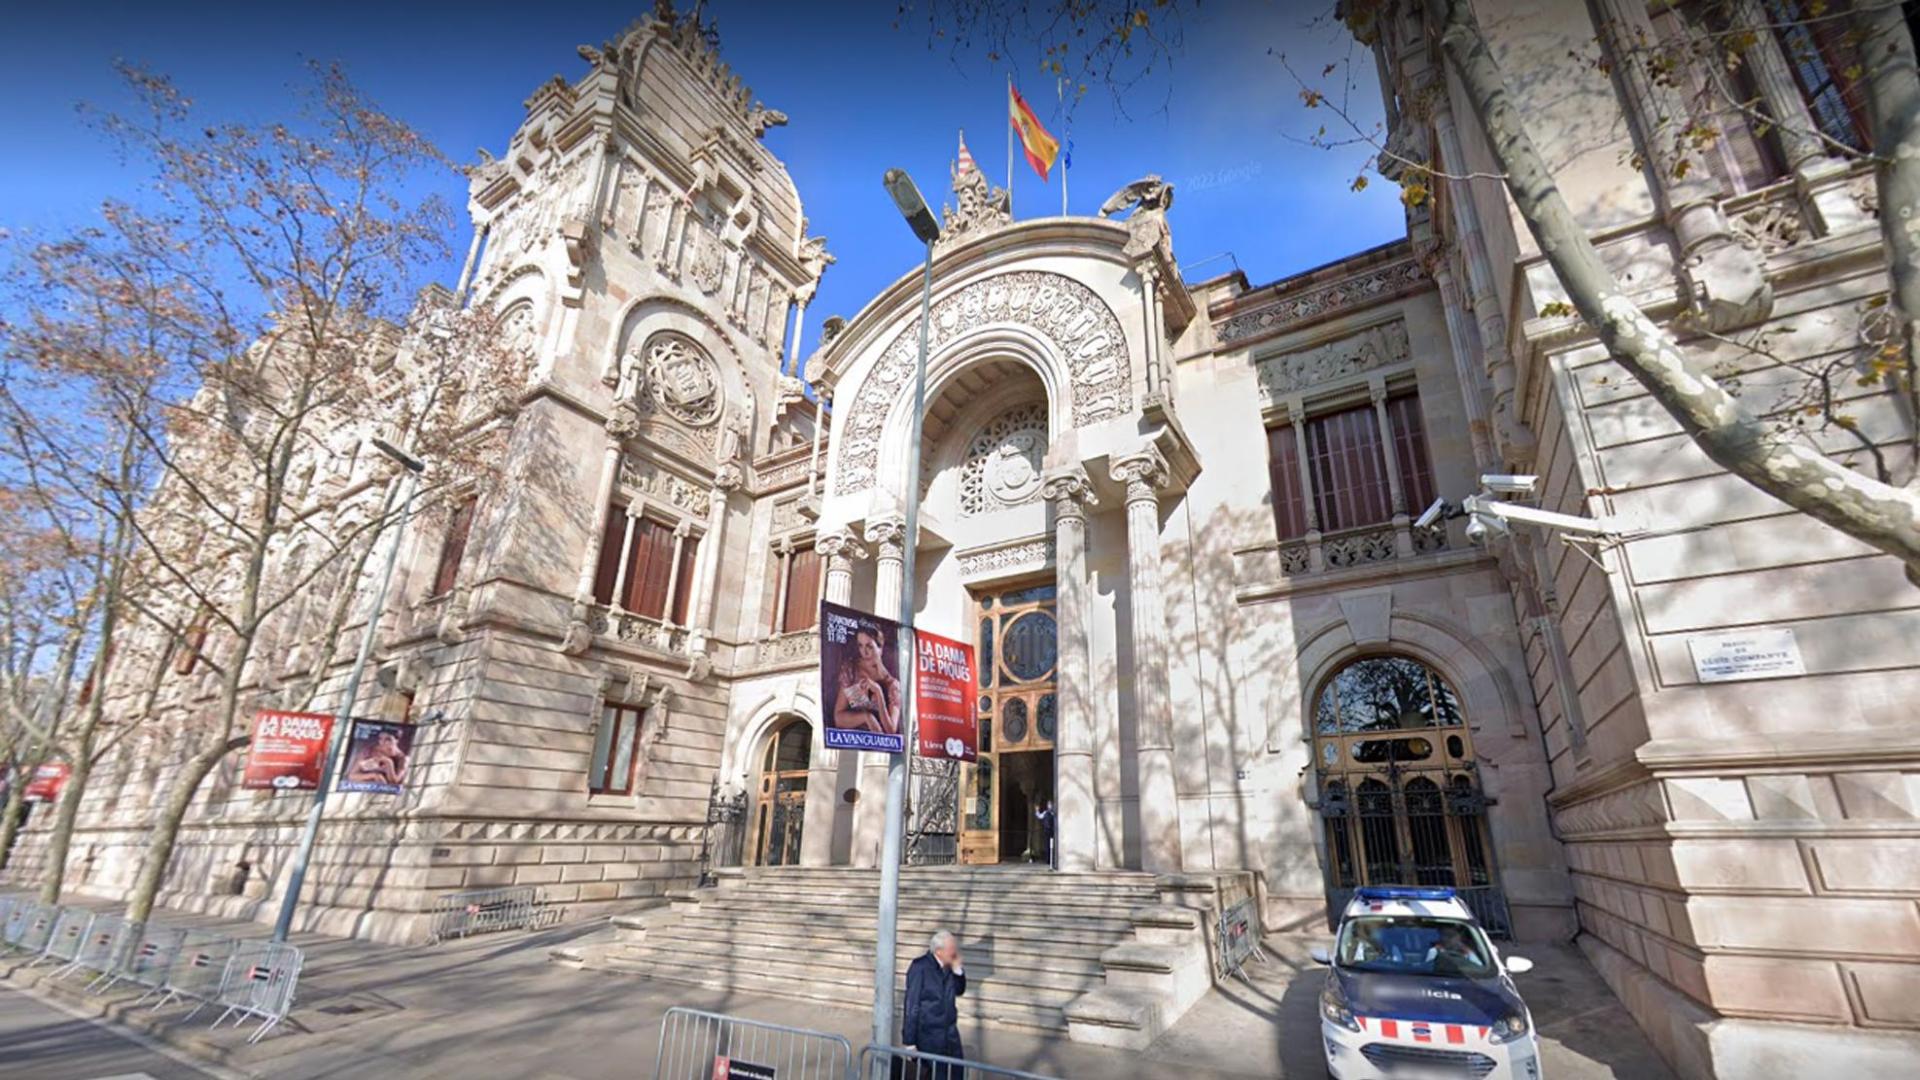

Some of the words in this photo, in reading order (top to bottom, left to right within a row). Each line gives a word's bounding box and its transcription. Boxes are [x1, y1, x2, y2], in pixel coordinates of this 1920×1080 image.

[919, 638, 934, 657] LA
[935, 642, 966, 666] DAMA
[920, 656, 936, 673] DE
[937, 659, 971, 683] PIQUES
[261, 715, 279, 727] LA
[829, 731, 843, 744] LA
[842, 732, 899, 748] VANGUARDIA
